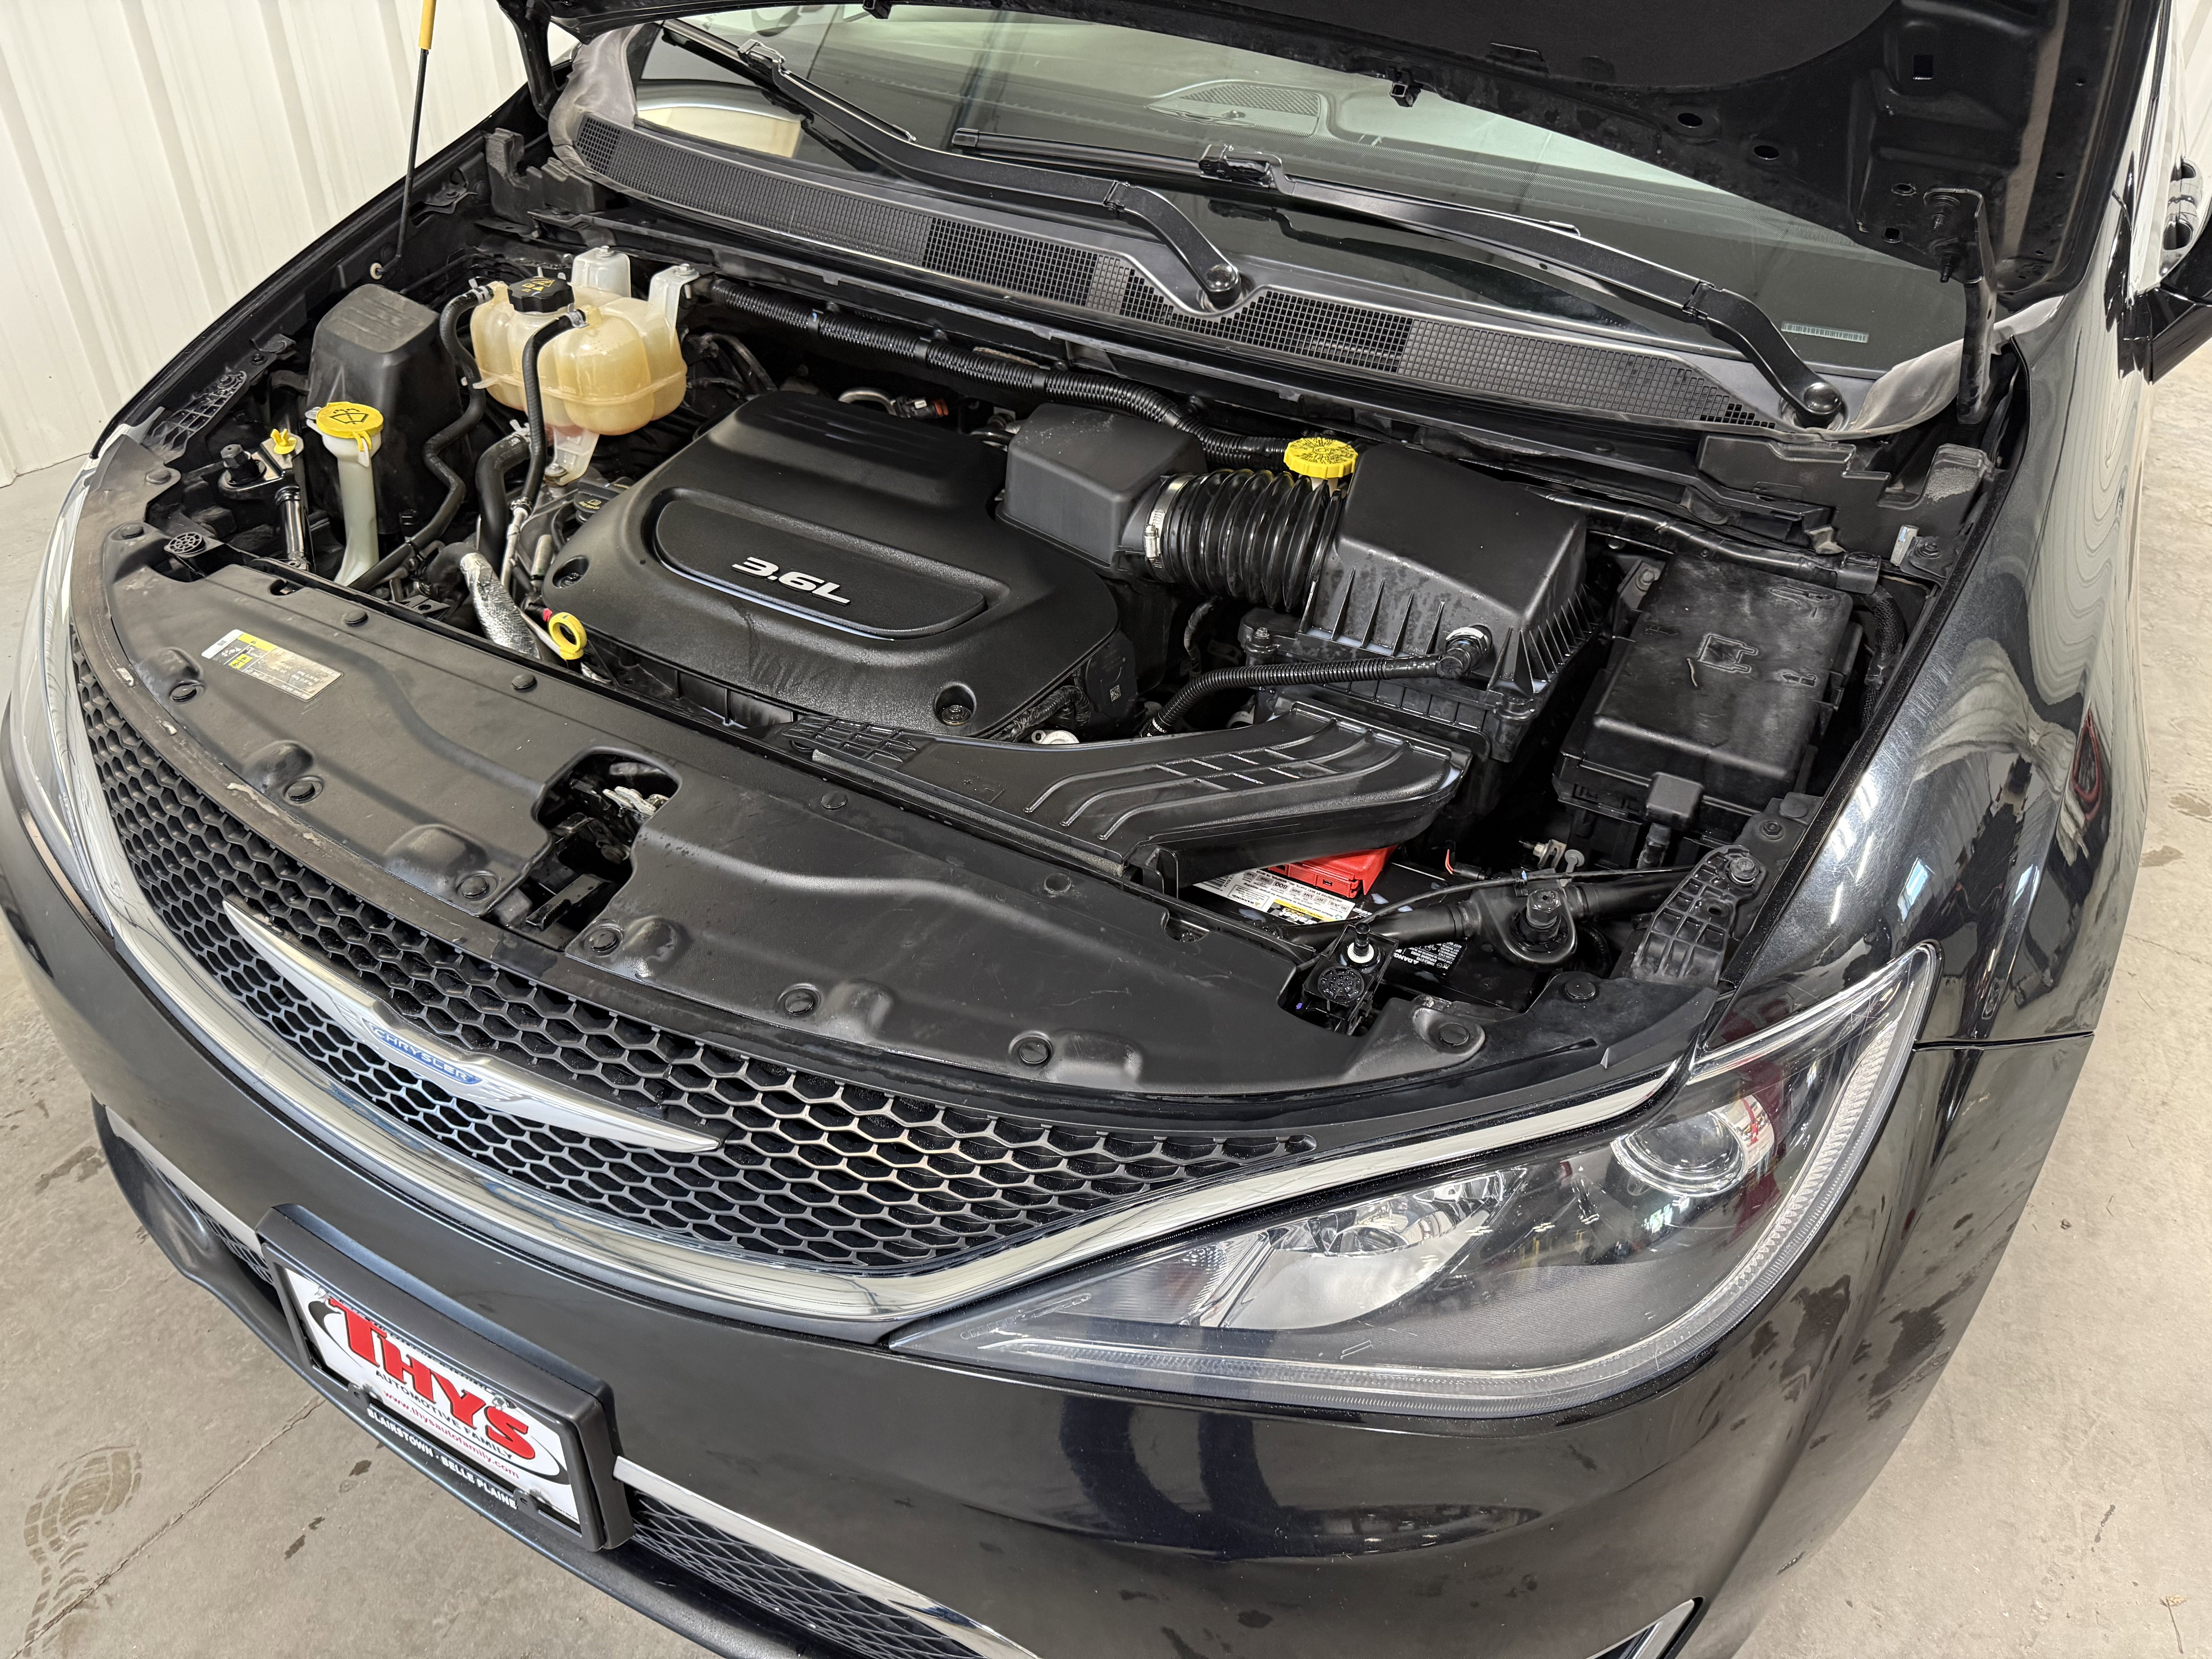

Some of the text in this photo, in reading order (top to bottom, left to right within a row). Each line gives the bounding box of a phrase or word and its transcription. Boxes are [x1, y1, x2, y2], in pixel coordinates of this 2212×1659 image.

[732, 556, 851, 605] 3.6L
[1393, 952, 1413, 963] DANG
[374, 1028, 467, 1082] CHRYSLER
[328, 1297, 536, 1460] THYS
[376, 1369, 461, 1429] AUTOMOTIVE
[464, 1427, 513, 1460] FAMILY
[367, 1408, 517, 1510] BLAIRSTOWN BELLE PLAINE
[383, 1390, 519, 1479] www.thysautofamily.com
